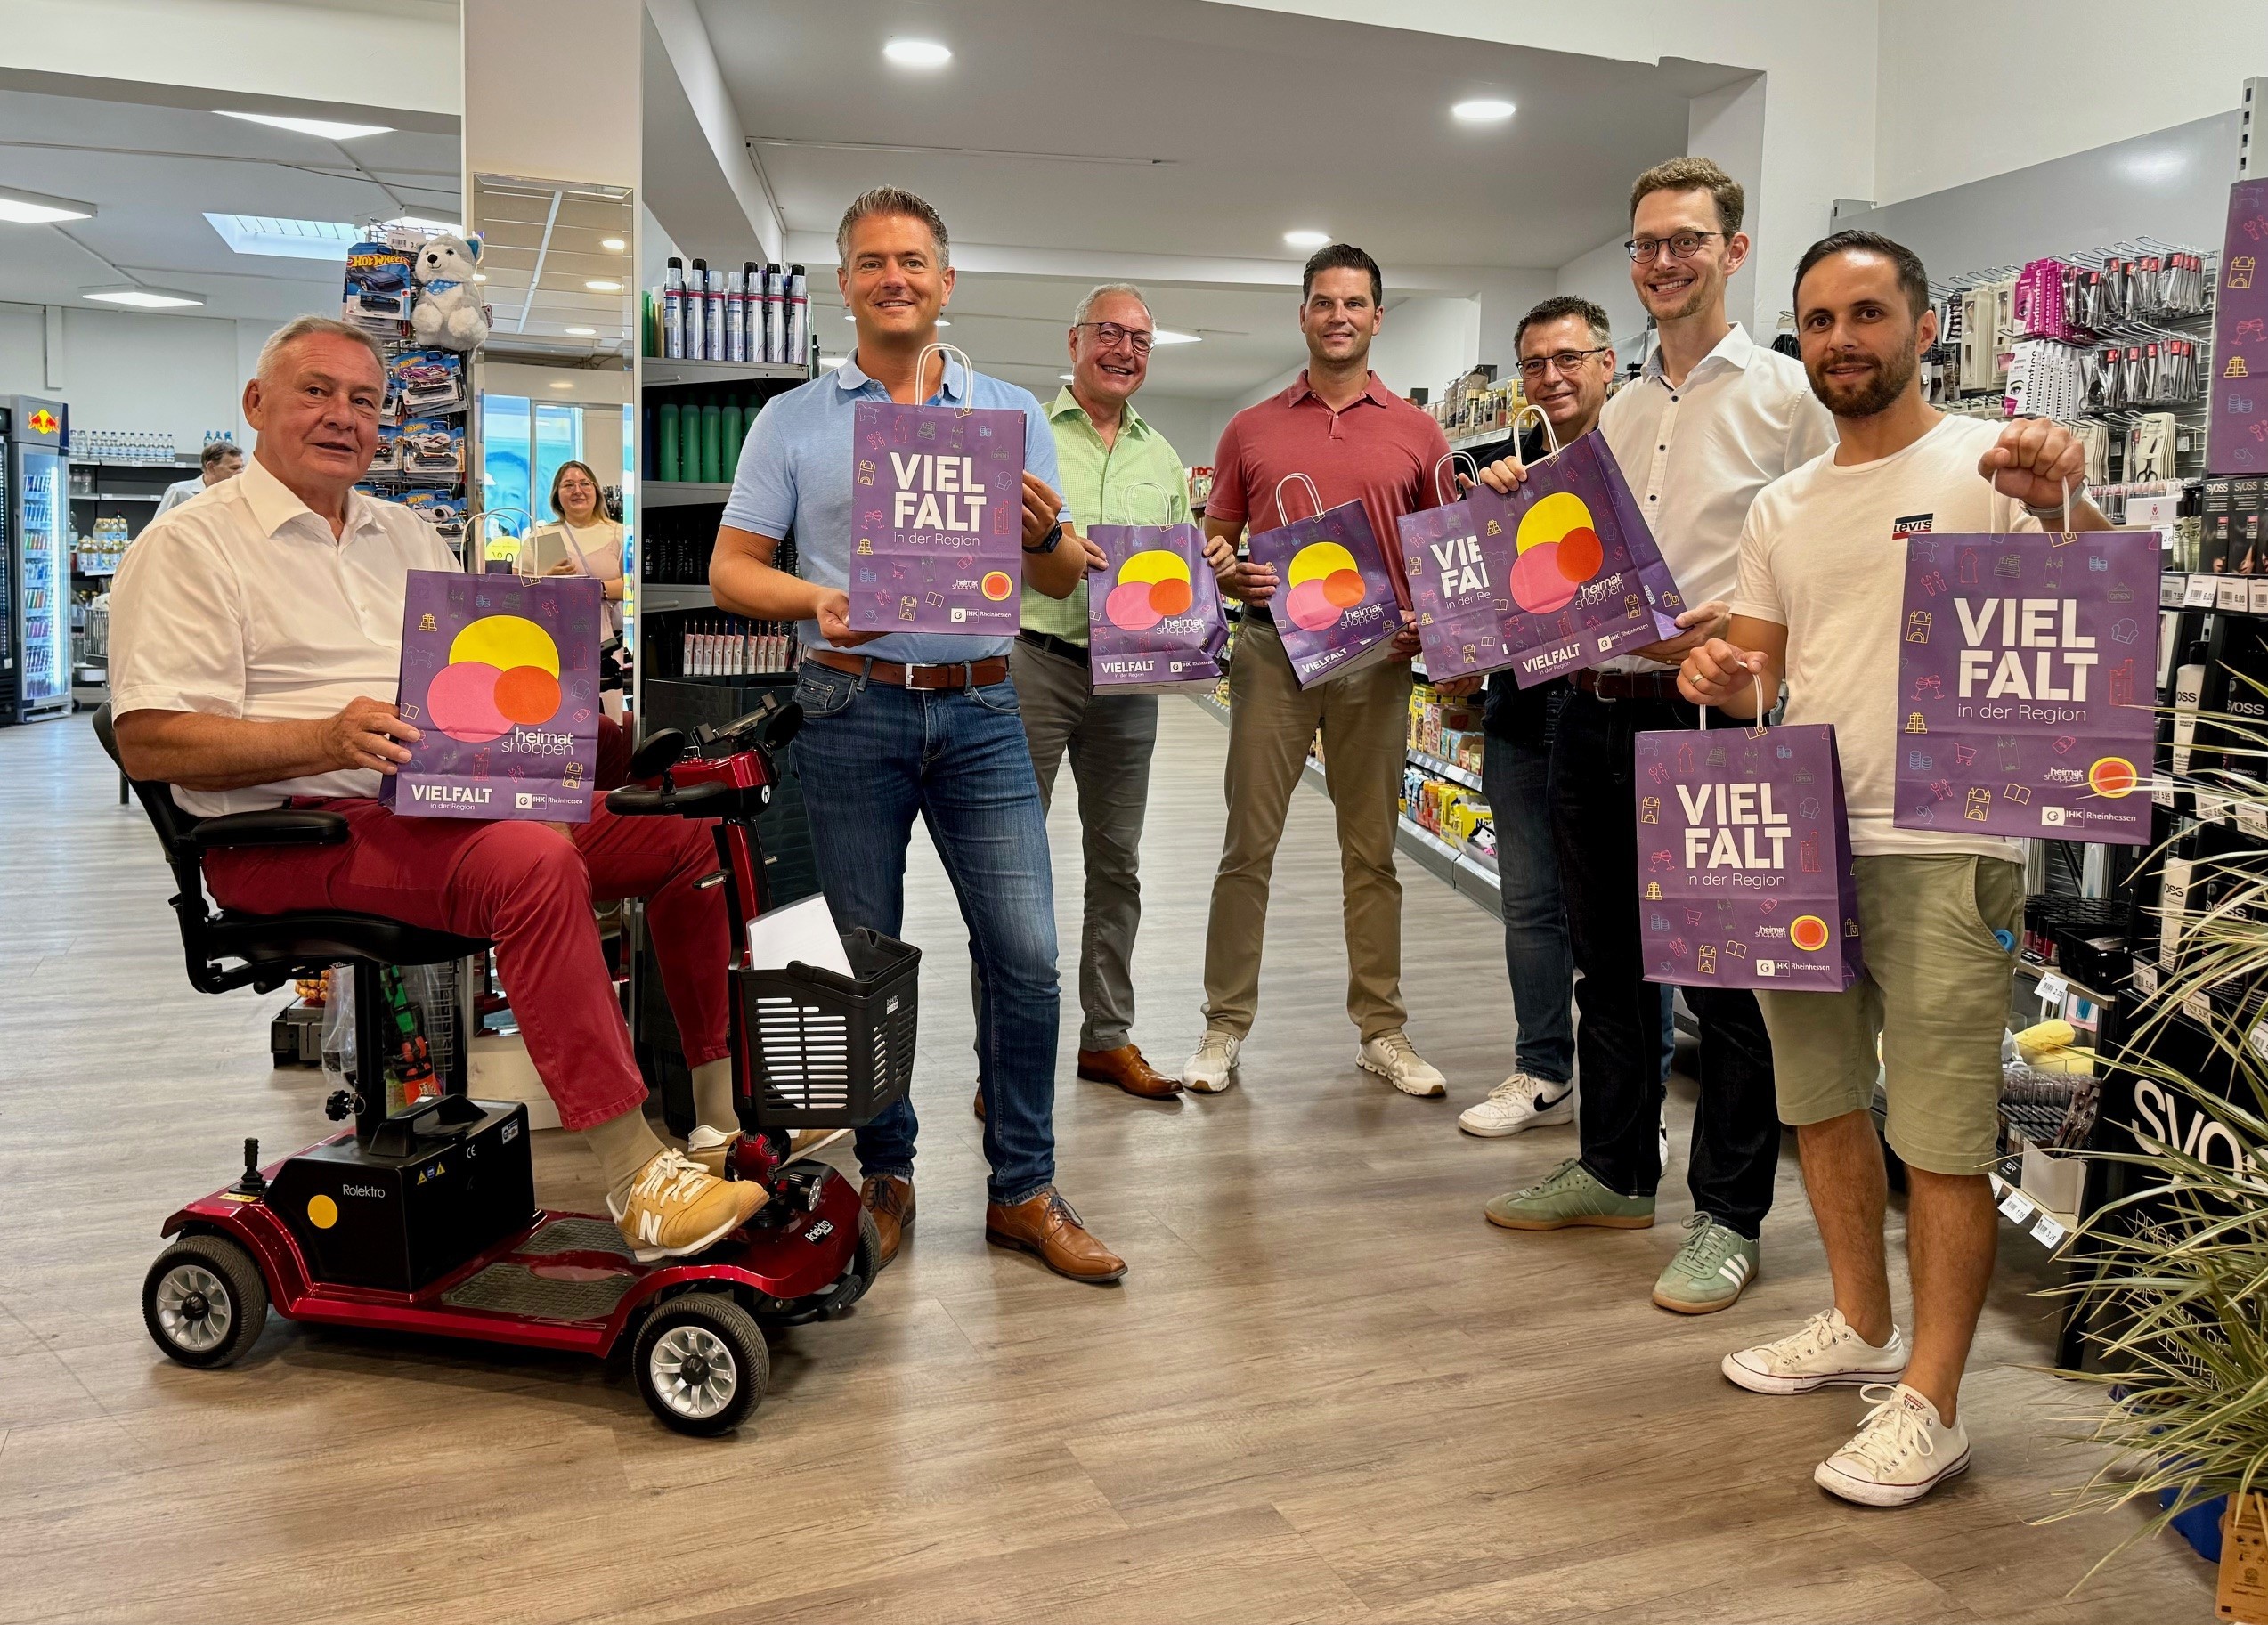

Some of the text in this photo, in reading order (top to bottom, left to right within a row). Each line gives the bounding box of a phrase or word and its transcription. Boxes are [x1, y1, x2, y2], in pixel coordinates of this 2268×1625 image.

[890, 451, 985, 493] VIEL
[894, 492, 987, 532] FALT
[894, 532, 980, 548] in der Region
[1430, 535, 1484, 571] VIE
[1581, 572, 1623, 597] heimat
[1446, 601, 1456, 610] in
[1459, 596, 1474, 606] der
[1575, 581, 1625, 611] shoppen
[1340, 609, 1385, 630] shoppen
[1345, 603, 1383, 620] heimat
[1156, 622, 1206, 636] shoppen
[1164, 617, 1205, 629] heimat
[1954, 597, 2096, 648] VIEL
[1101, 660, 1155, 674] VIELFALT
[1302, 647, 1347, 674] VIELFALT
[1522, 643, 1581, 673] VIELFALT
[1959, 650, 2099, 702] FALT
[1958, 703, 2087, 724] in der Region
[515, 727, 574, 745] heimat
[501, 738, 574, 758] shoppen
[2043, 773, 2084, 783] shoppen
[2050, 767, 2084, 776] heimat
[411, 784, 493, 804] VIELFALT
[1675, 782, 1789, 825] VIEL
[437, 802, 451, 810] der
[451, 803, 476, 812] Region
[2065, 810, 2136, 822] IHK Rheinhessen
[1685, 826, 1792, 869] FALT
[1686, 873, 1785, 890] in der Region
[1754, 930, 1786, 939] shoppen
[1760, 925, 1786, 934] heimat
[1791, 963, 1831, 971] Rheinhessen
[343, 1184, 386, 1198] Rolektro
[638, 1209, 663, 1246] N
[804, 1219, 831, 1242] Rolektro
